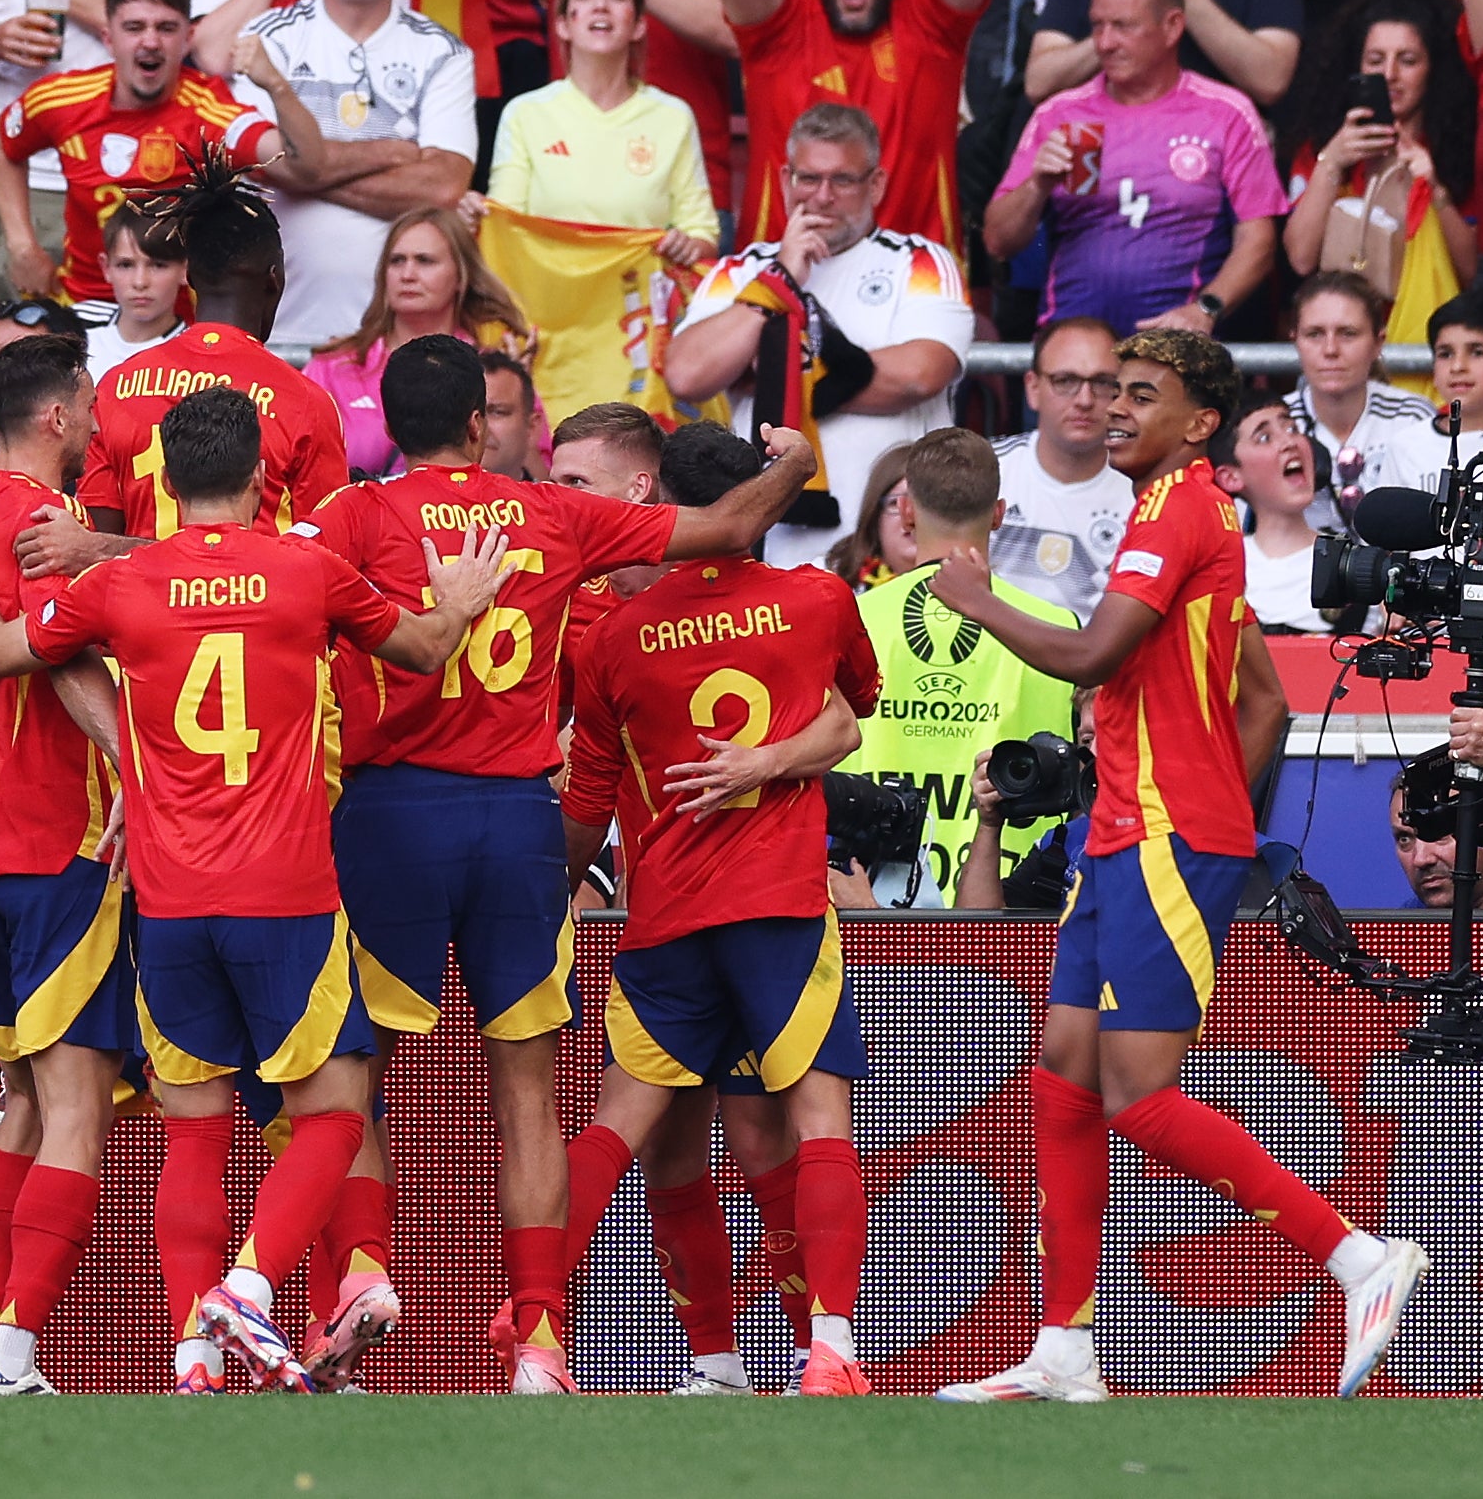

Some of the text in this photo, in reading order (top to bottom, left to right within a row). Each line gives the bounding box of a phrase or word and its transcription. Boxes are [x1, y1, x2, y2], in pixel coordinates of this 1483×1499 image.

[1119, 178, 1150, 229] 4
[116, 367, 232, 400] WILLIAM
[420, 498, 526, 533] RODRIGO
[168, 572, 267, 608] NACHO
[638, 602, 792, 655] CARVAJAL
[917, 676, 964, 697] UEFA
[173, 632, 260, 787] 4
[880, 699, 1001, 722] EURO2024
[902, 724, 976, 740] GERMANY
